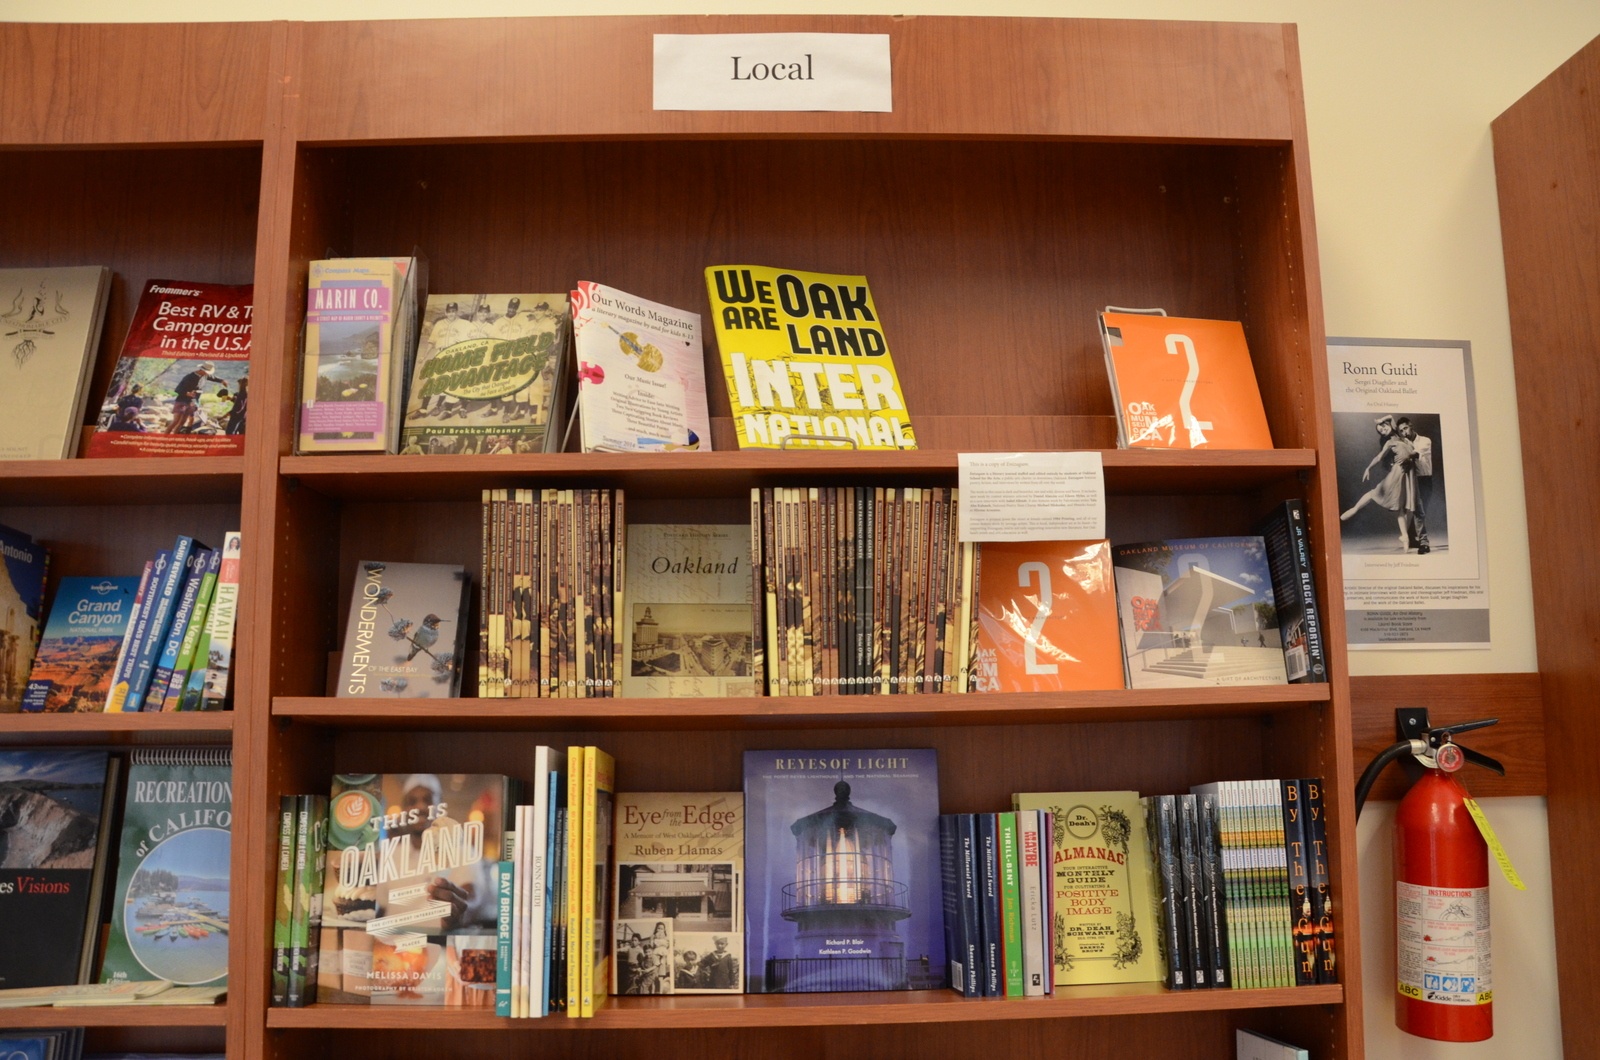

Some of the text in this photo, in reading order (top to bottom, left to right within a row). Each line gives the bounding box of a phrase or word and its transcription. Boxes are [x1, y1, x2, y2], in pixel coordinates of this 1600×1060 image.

[730, 54, 815, 80] Local
[149, 284, 201, 297] Frommer's
[314, 288, 382, 310] MARIN CO.
[776, 273, 876, 322] OAK
[158, 301, 197, 317] Best
[199, 304, 227, 318] RV
[226, 306, 240, 319] &
[591, 293, 694, 331] Our Words Magazine
[722, 306, 780, 331] ARE
[597, 308, 617, 319] literary
[618, 315, 643, 326] magazine
[651, 323, 661, 331] and
[670, 328, 681, 337] kids
[160, 335, 177, 349] in
[181, 336, 210, 350] the
[786, 323, 886, 357] LAND
[419, 332, 555, 380] HOME FIELD
[418, 351, 549, 399] ADVANTAGE
[1343, 362, 1418, 376] Ronn Guidi
[729, 352, 903, 411] INTER
[1354, 379, 1371, 387] Sergei
[449, 427, 522, 435] Brekke-Miesner
[742, 413, 917, 447] NATIONAL
[1120, 546, 1159, 556] OAKLAND
[164, 540, 188, 596] OAHU REVEALED
[651, 556, 739, 574] Oakland
[141, 577, 160, 619] SOUTHWEST
[1301, 572, 1313, 604] BLOCK
[77, 599, 122, 611] Grand
[182, 576, 211, 656] Discover Las Vegas
[213, 586, 234, 640] HAWAII
[68, 611, 122, 627] Canyon
[165, 577, 199, 657] Washington, DC
[348, 567, 384, 695] WONDERMENTS
[1305, 608, 1321, 660] REPORTIN'
[129, 640, 140, 657] BEST
[123, 658, 135, 679] TRIPS
[776, 758, 909, 770] REYES OF LIGHT
[283, 811, 292, 834] COMPASS
[299, 811, 308, 834] COMPASS
[369, 802, 448, 832] THIS IS
[623, 805, 736, 831] Eye from the Edge
[135, 840, 149, 858] of
[281, 849, 290, 870] CAMERA
[297, 849, 306, 870] CAMERA
[339, 820, 484, 889] OAKLAND
[506, 838, 515, 861] Finn
[635, 845, 723, 856] Ruben Llamas
[1004, 827, 1014, 886] THRILL-BENT
[1024, 831, 1038, 867] MAYBE
[1054, 846, 1125, 866] ALMANAC
[17, 876, 70, 894] Visions
[501, 872, 510, 895] BAY
[533, 855, 542, 907] RONN GUIDI
[1056, 890, 1119, 898] POSITIVE
[1070, 898, 1106, 906] BODY
[1428, 890, 1472, 898] INSTRUCTIONS
[413, 908, 446, 919] INTERESTING
[500, 897, 510, 939] BRIDGE
[1030, 913, 1038, 931] Lutz
[1066, 907, 1112, 915] IMAGE
[1007, 912, 1015, 943] Richman
[366, 971, 442, 980] MELISSA DAVIS
[1400, 985, 1419, 996] ABC
